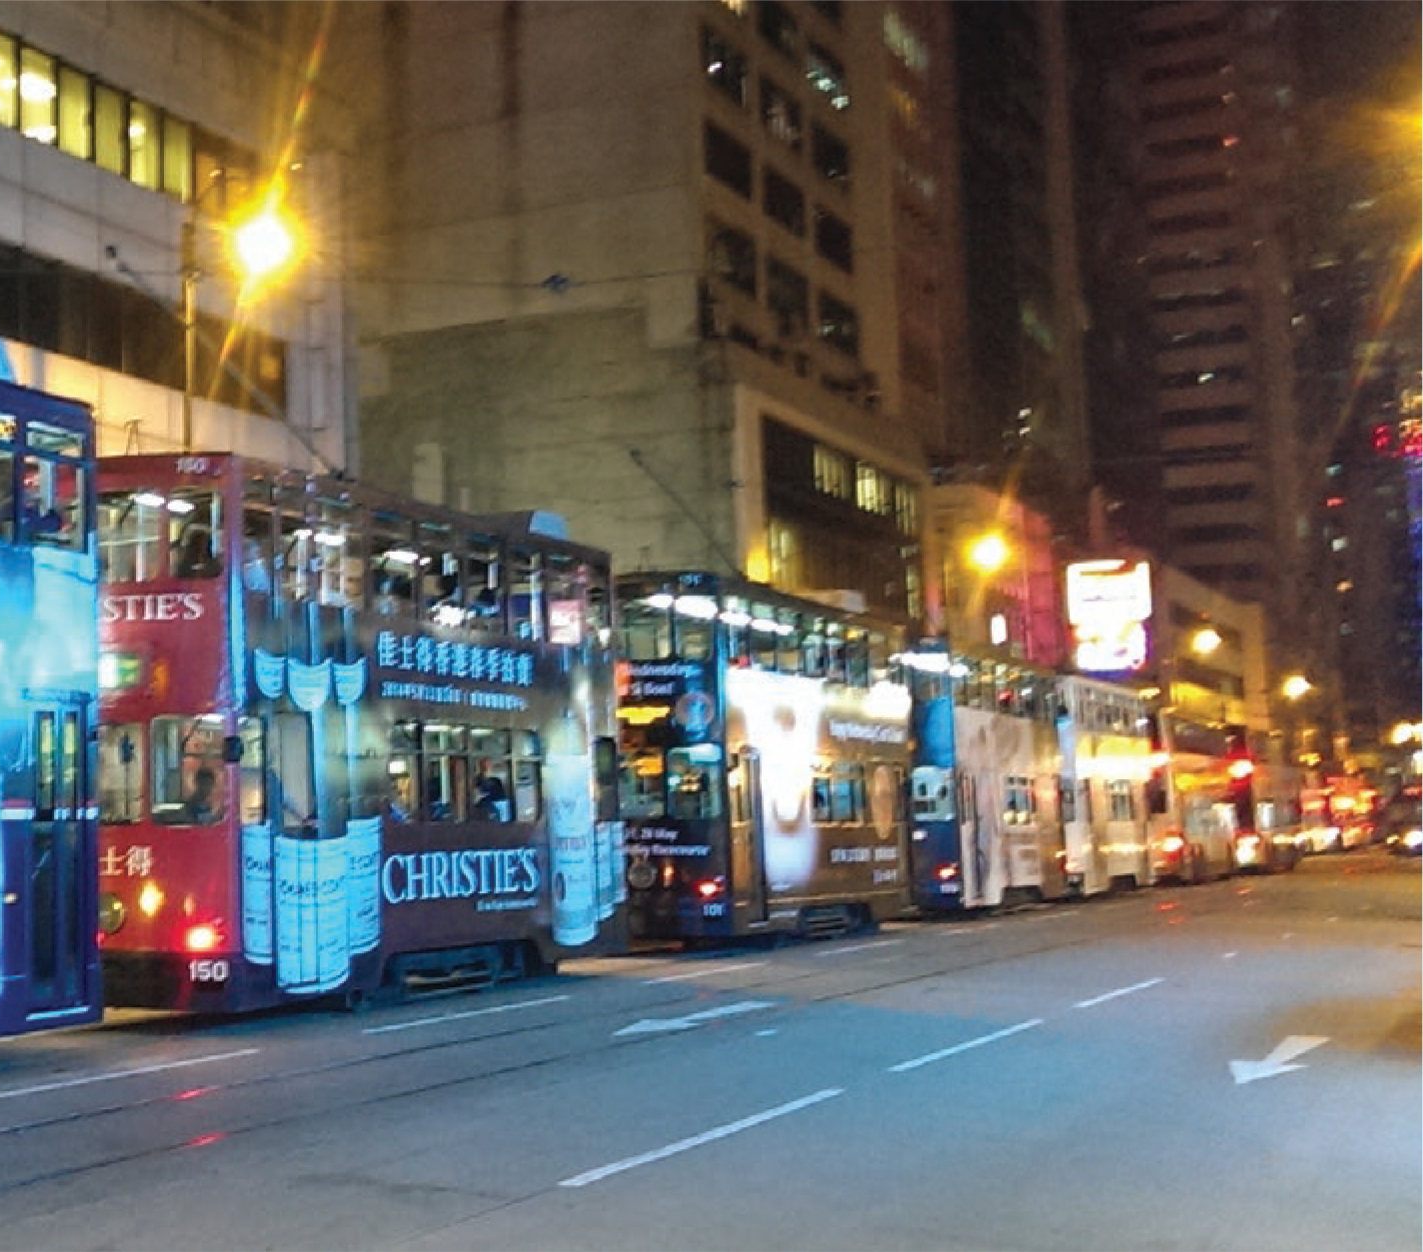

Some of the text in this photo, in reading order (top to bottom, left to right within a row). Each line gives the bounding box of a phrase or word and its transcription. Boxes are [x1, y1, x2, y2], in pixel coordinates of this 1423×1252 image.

[103, 592, 205, 622] STIE'S
[98, 844, 154, 877] 士得
[381, 848, 540, 904] CHRISTIE'S
[189, 960, 229, 982] 150
